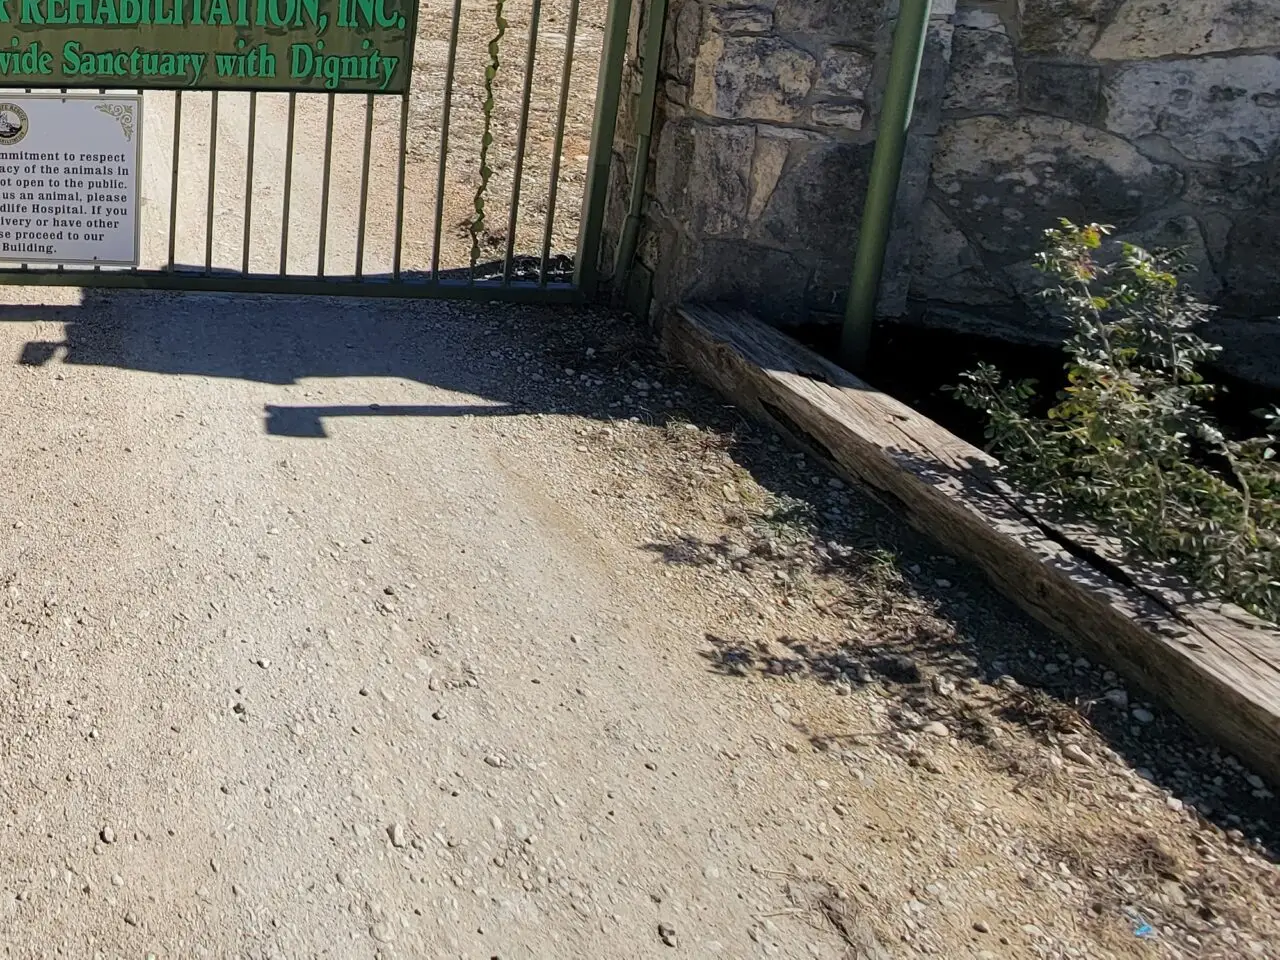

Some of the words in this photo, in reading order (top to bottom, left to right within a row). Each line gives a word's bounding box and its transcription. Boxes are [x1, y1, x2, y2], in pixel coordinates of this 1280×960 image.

[62, 40, 207, 86] Sanctuary
[216, 39, 276, 79] with
[291, 39, 399, 90] Dignity
[64, 152, 75, 161] to
[80, 152, 126, 163] respect
[24, 164, 36, 174] of
[40, 165, 60, 174] the
[63, 165, 113, 176] animals
[117, 166, 129, 176] in
[16, 179, 45, 189] open
[49, 178, 60, 188] to
[64, 178, 84, 188] the
[88, 179, 127, 190] public.
[2, 191, 16, 200] us
[19, 192, 34, 201] an
[38, 191, 82, 202] animal,
[86, 192, 128, 203] please
[31, 204, 87, 215] Hospital.
[91, 205, 102, 215] If
[105, 207, 128, 217] you
[36, 218, 49, 227] or
[52, 218, 82, 228] have
[86, 219, 120, 229] other
[15, 230, 63, 241] proceed
[67, 231, 79, 241] to
[83, 233, 104, 241] our
[2, 242, 57, 254] Building.
